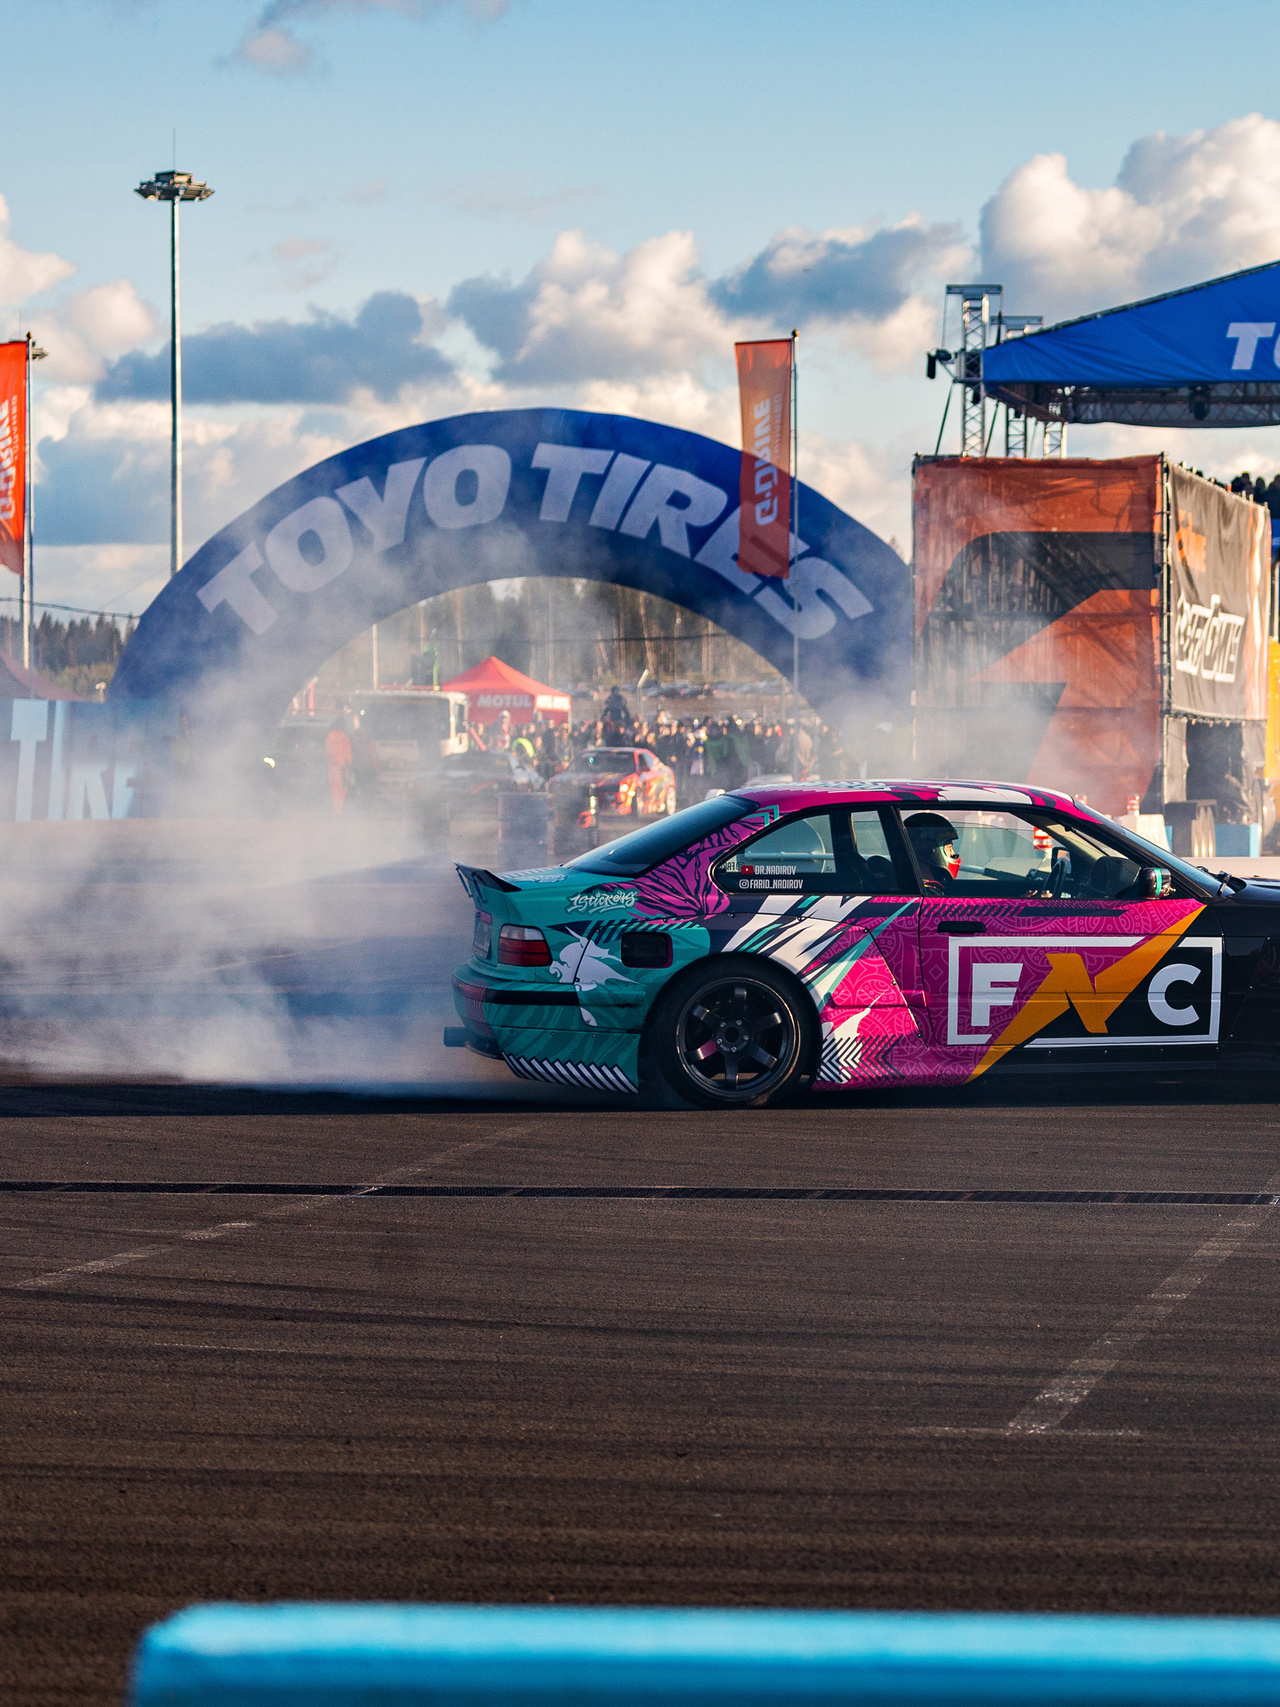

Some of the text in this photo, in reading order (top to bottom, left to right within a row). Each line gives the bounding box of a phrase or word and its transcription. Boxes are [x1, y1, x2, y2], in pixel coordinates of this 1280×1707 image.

[197, 442, 874, 640] TOYO TIRES
[477, 694, 531, 708] MOTUL
[750, 879, 804, 889] FARID_NADIROV
[970, 953, 1201, 1033] FNC
